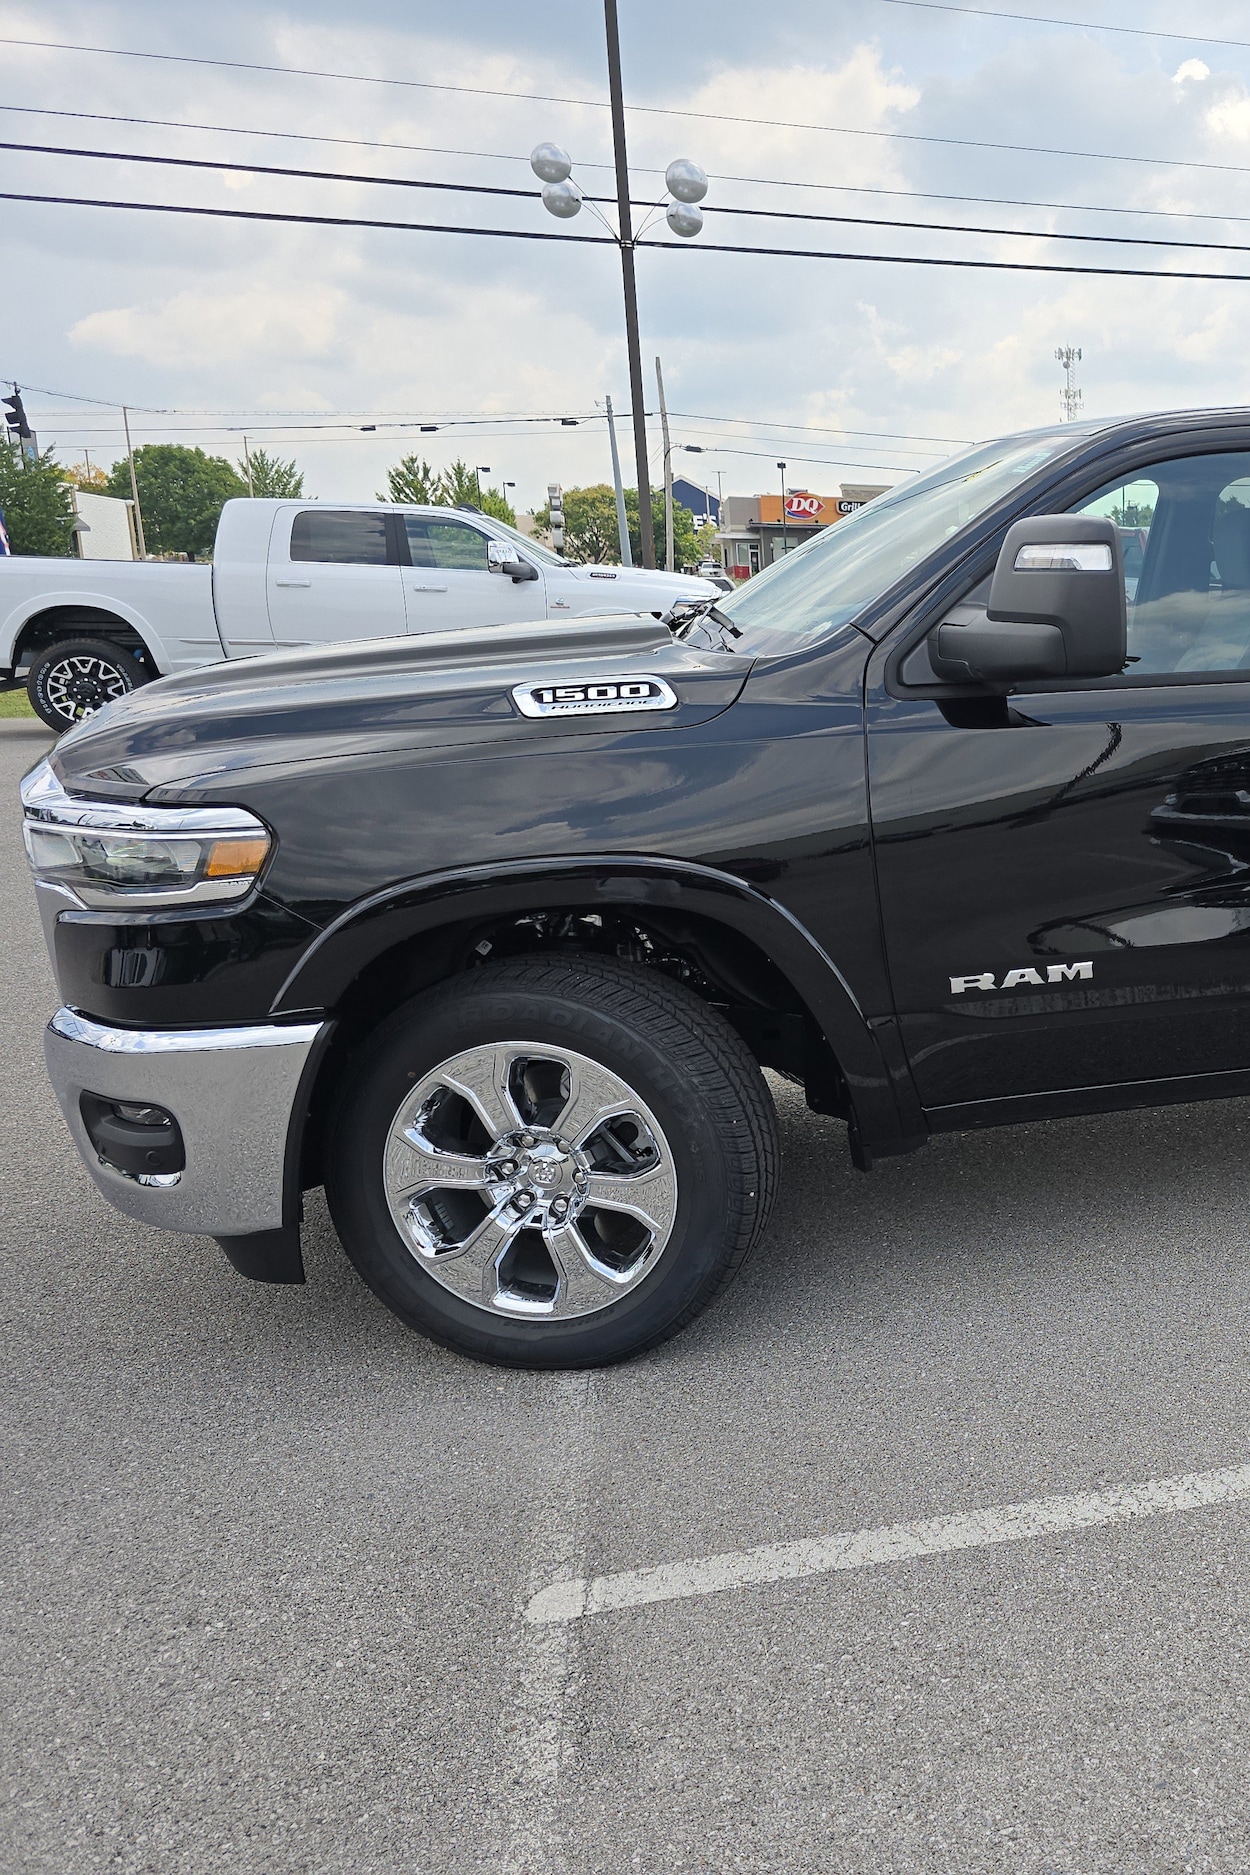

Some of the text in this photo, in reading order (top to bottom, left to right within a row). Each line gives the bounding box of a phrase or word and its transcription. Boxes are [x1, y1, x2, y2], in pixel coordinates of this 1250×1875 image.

[791, 497, 819, 514] DQ
[538, 683, 650, 704] 1500
[948, 961, 1094, 994] RAM
[459, 1003, 648, 1065] ROADIAN
